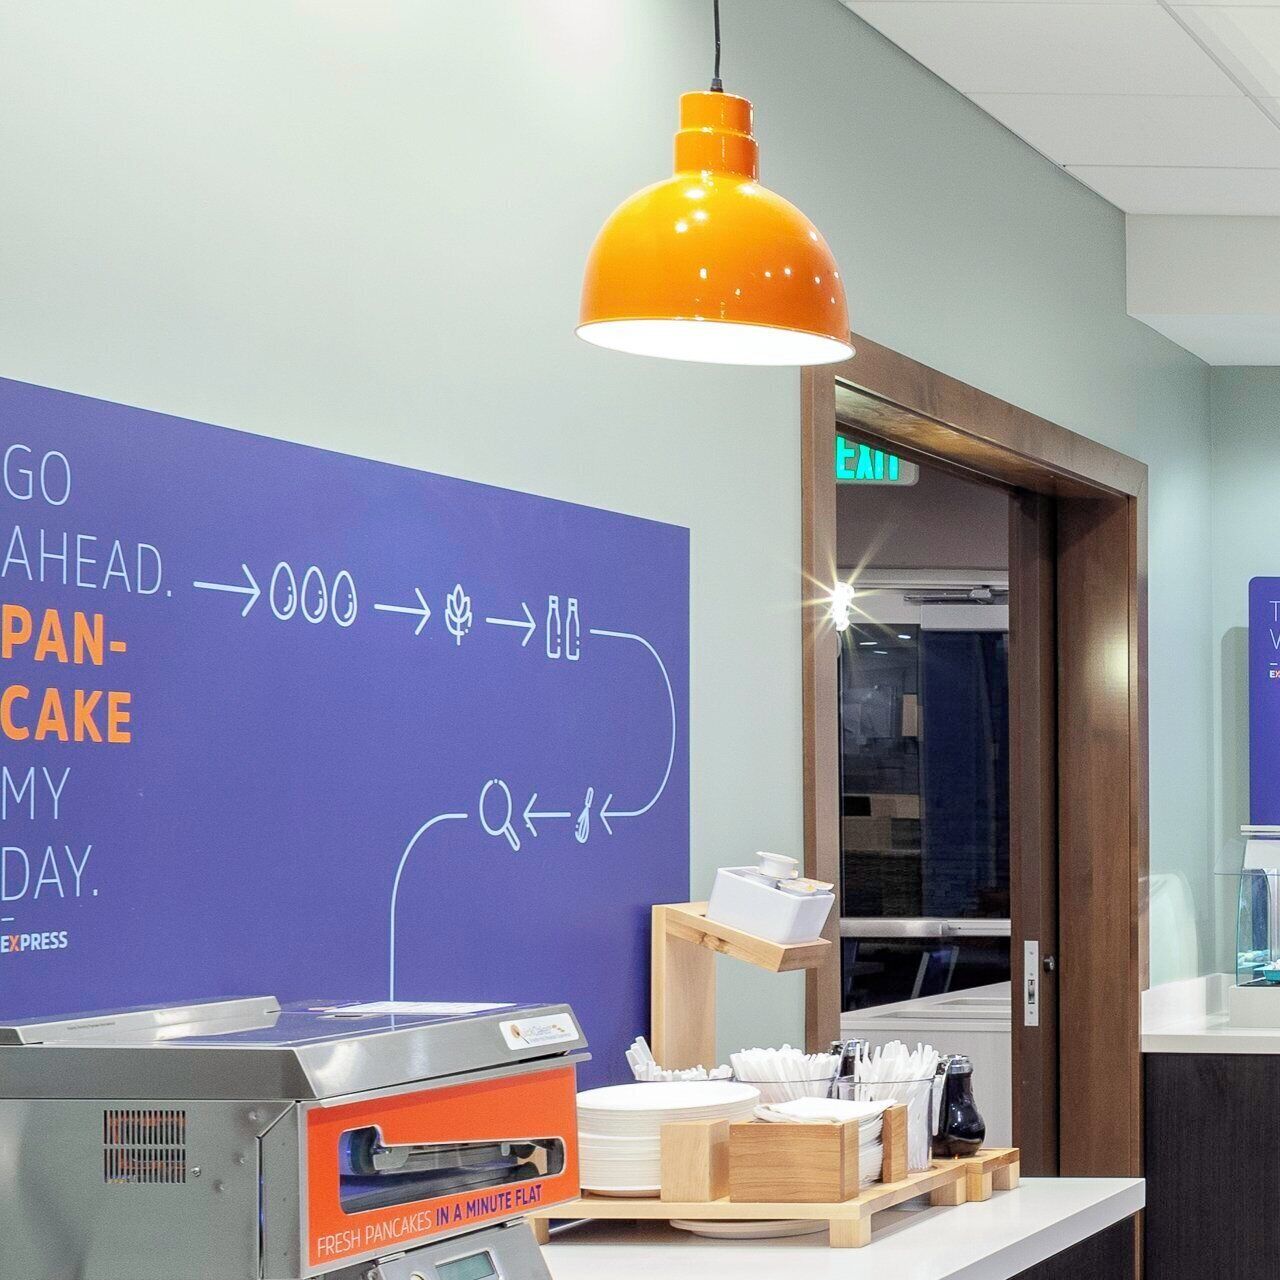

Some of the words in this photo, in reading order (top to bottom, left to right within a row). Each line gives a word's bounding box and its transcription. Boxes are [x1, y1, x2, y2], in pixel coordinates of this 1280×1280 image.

[2, 443, 72, 506] GO
[1, 524, 173, 598] AHEAD.
[1, 603, 127, 666] PAN-
[0, 684, 132, 744] CAKE
[1, 766, 71, 821] MY
[1, 844, 99, 902] DAY.
[0, 931, 69, 953] EXPRESS
[317, 1228, 362, 1259] FRESH
[365, 1210, 433, 1246] PANCAKES
[436, 1207, 450, 1227] IN
[453, 1203, 463, 1222] A
[466, 1191, 513, 1219] MINUTE
[515, 1184, 543, 1207] FLAT
